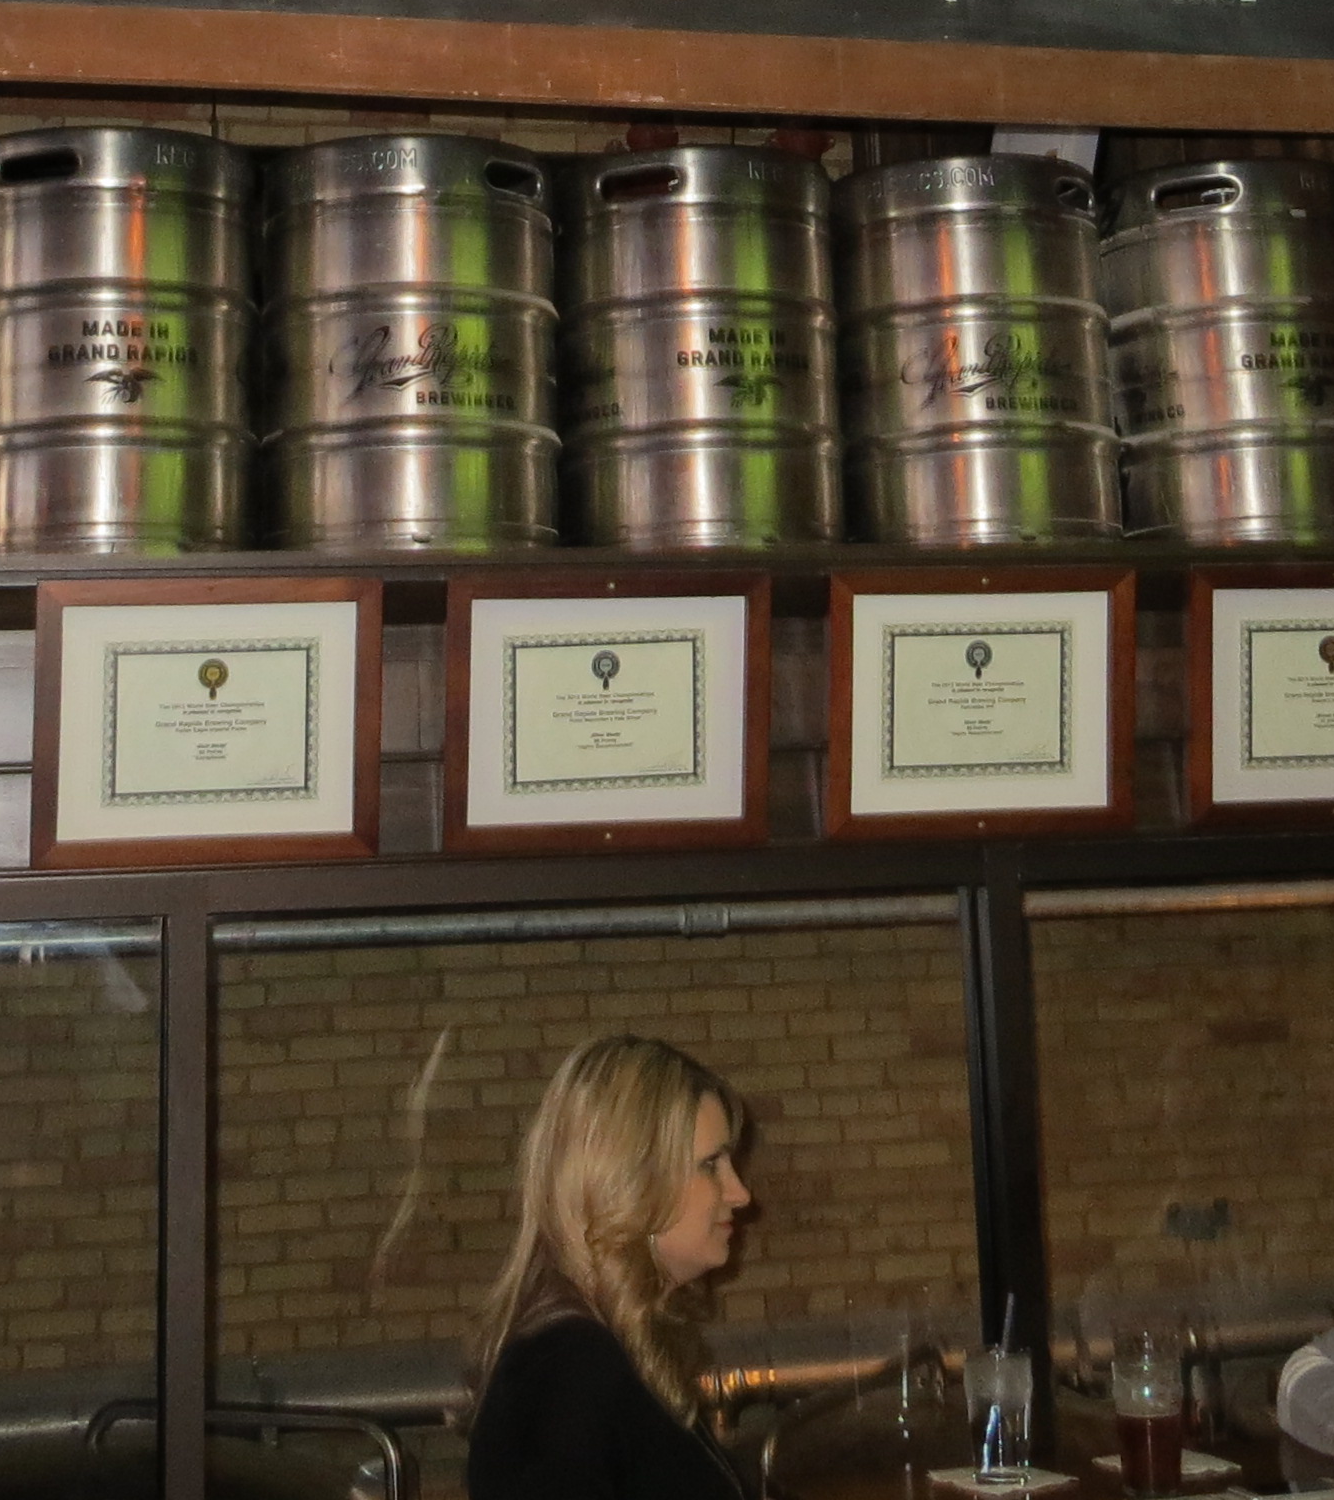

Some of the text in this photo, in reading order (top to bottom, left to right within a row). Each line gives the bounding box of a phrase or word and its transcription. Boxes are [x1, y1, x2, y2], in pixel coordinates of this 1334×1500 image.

[82, 319, 143, 337] MADE
[48, 343, 120, 363] GRAND
[677, 350, 745, 368] GRAND
